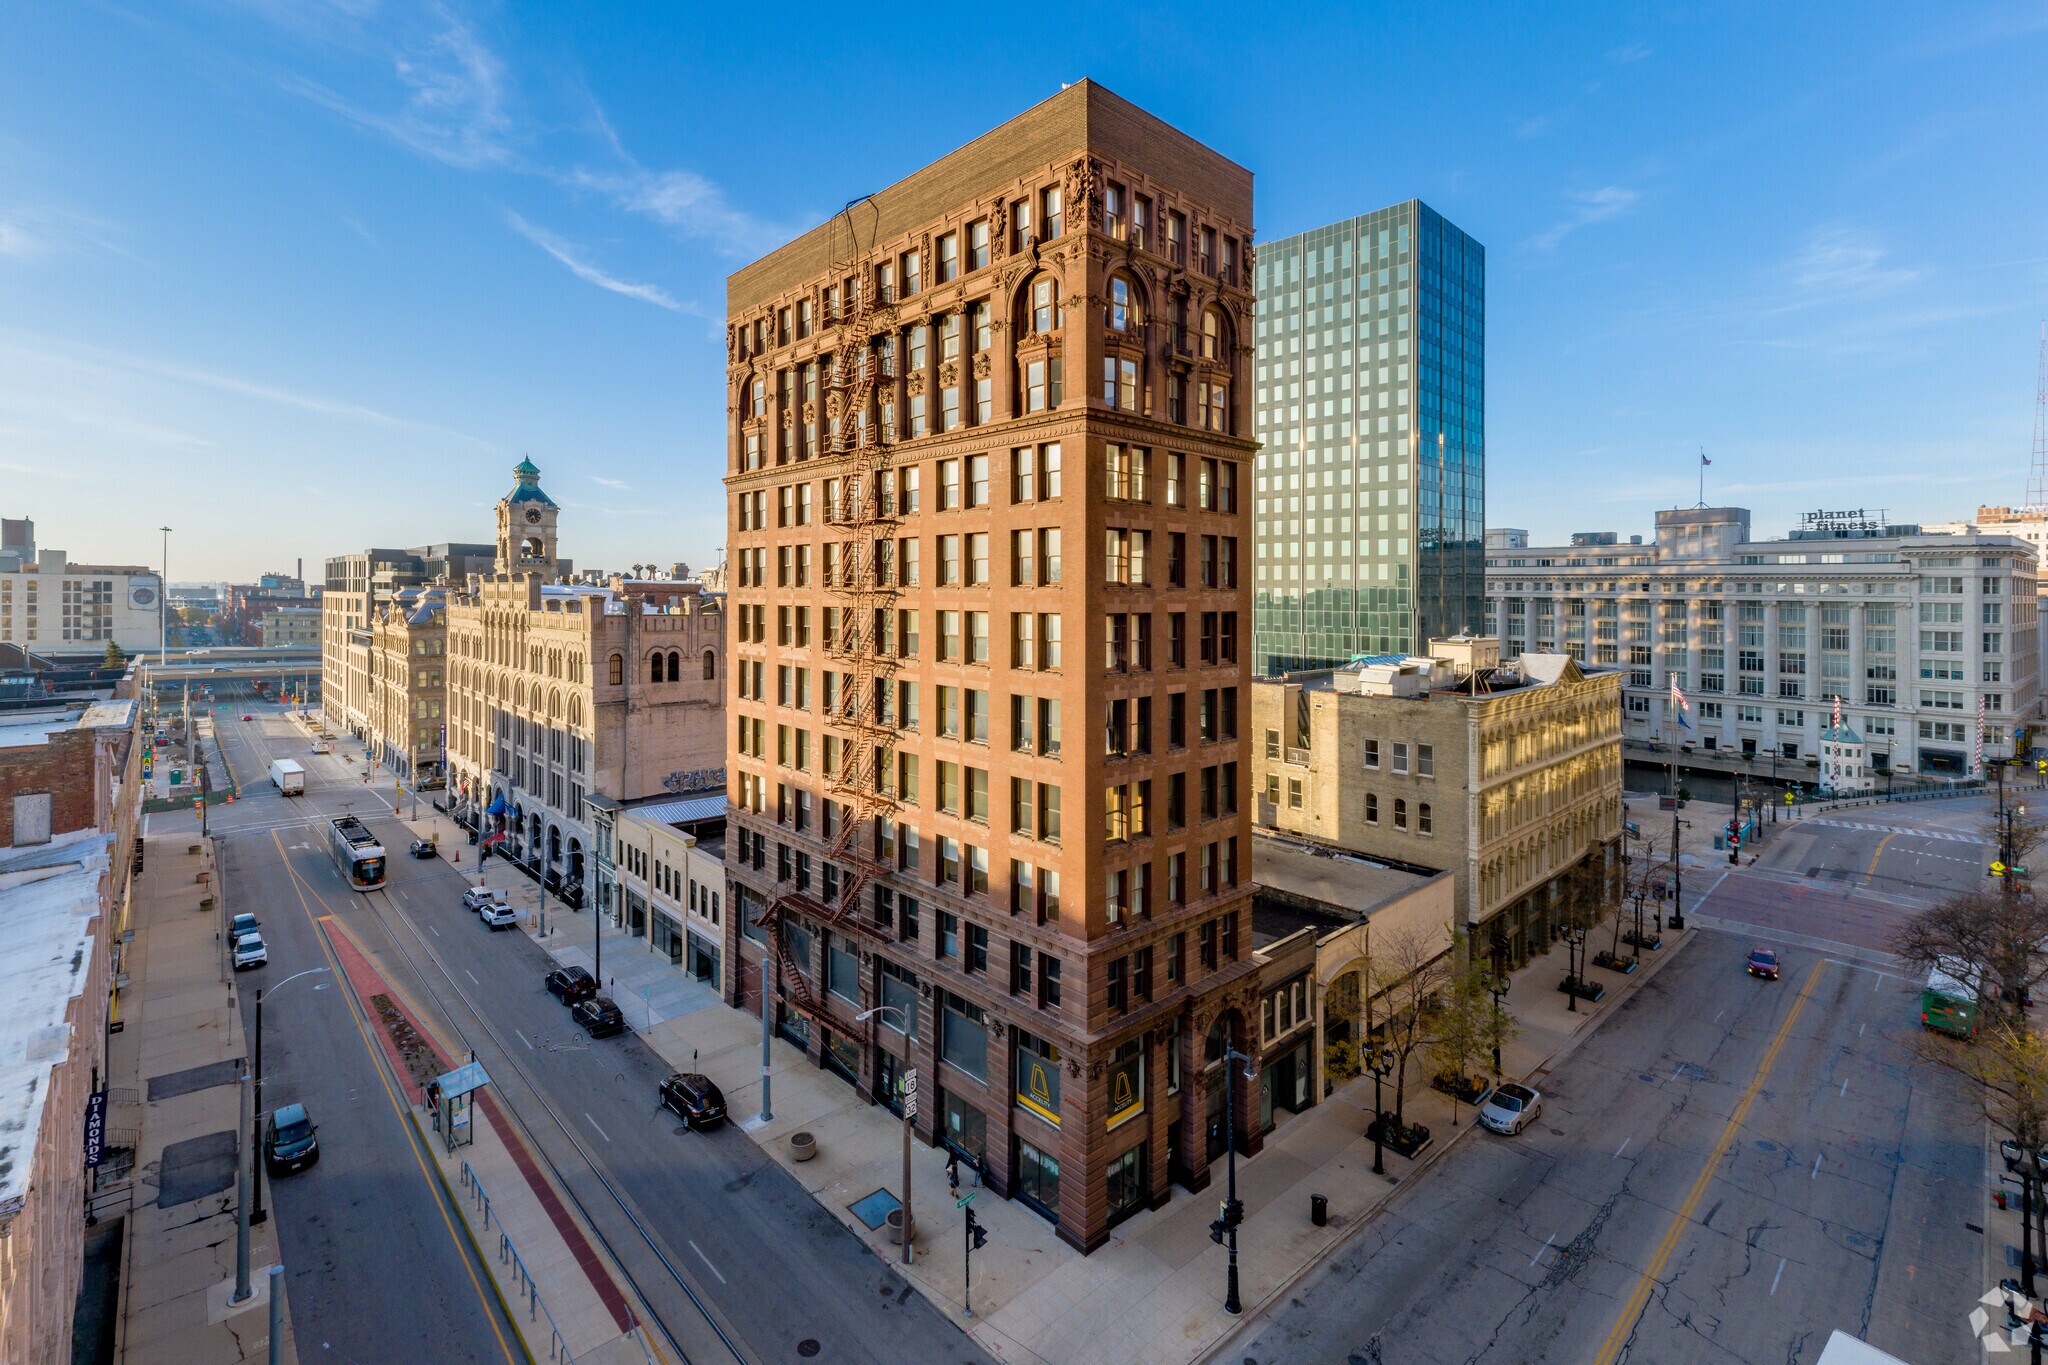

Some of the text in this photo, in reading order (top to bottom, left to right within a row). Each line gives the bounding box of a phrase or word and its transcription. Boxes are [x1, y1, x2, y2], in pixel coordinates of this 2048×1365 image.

[1807, 508, 1865, 523] planet
[1816, 520, 1878, 531] fitness
[906, 1080, 915, 1092] 18
[906, 1103, 916, 1116] 32
[89, 1096, 102, 1163] DIAMONDS
